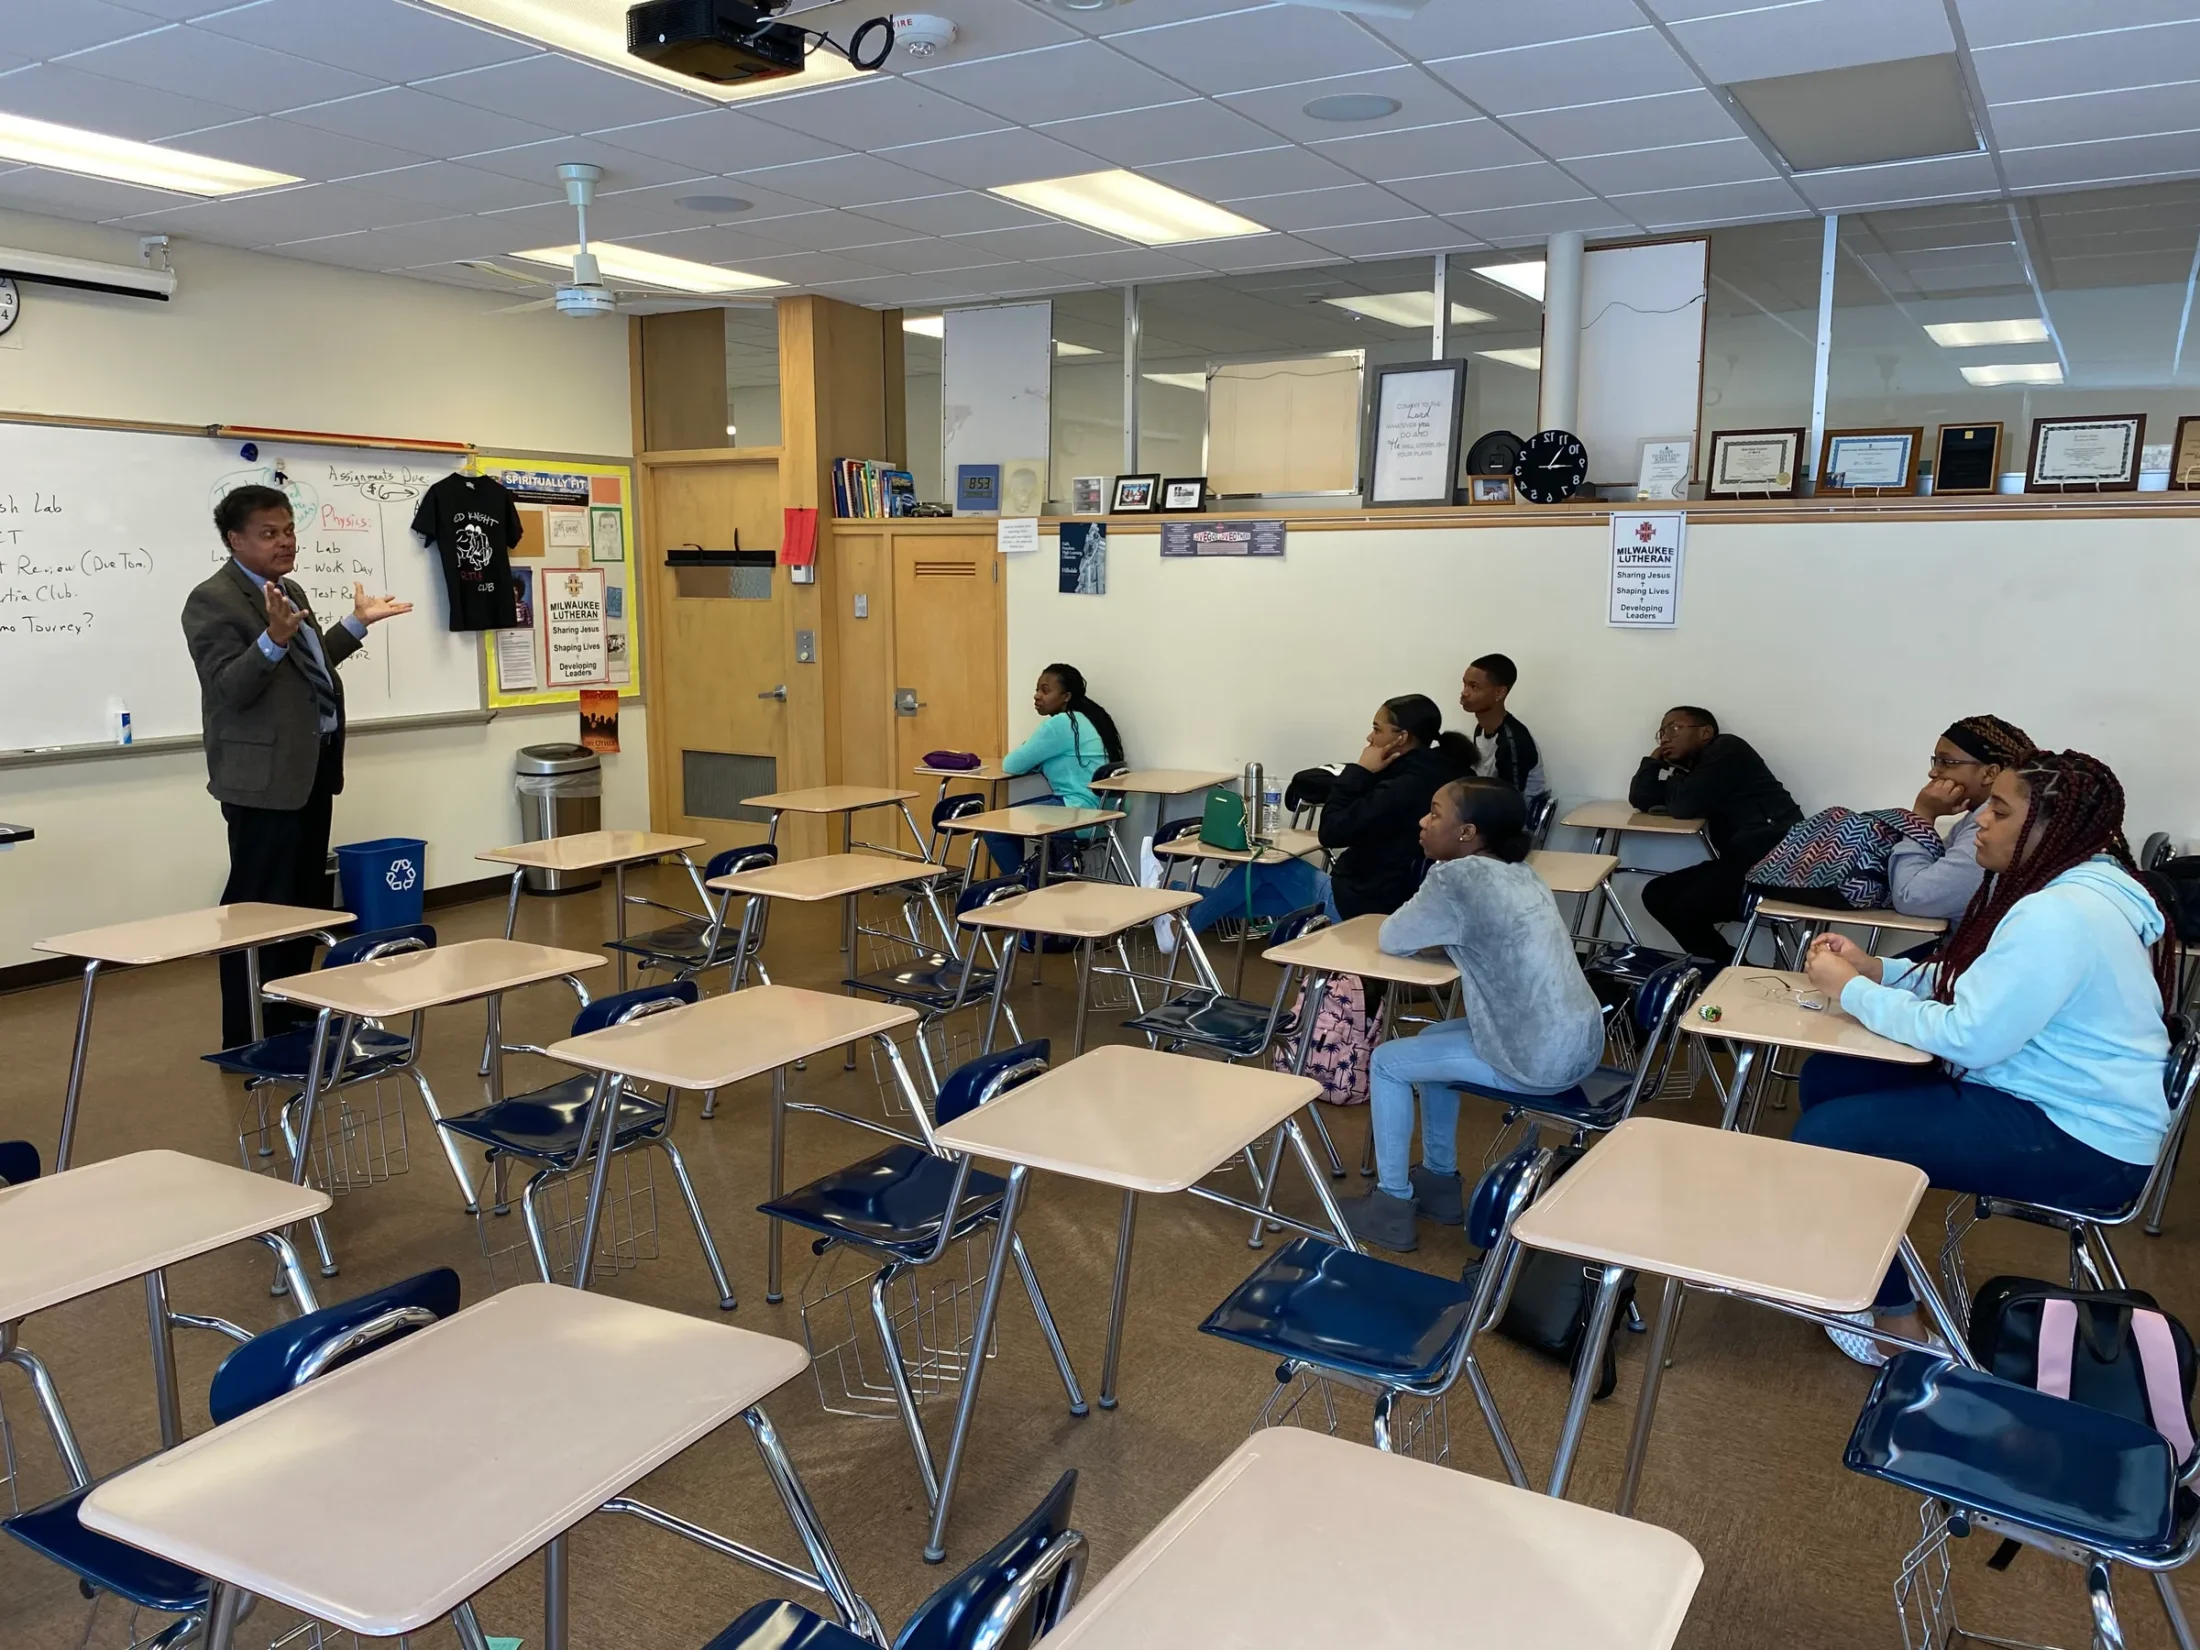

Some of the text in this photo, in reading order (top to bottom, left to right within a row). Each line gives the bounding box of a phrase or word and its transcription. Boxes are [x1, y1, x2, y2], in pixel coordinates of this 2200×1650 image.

[5, 293, 13, 305] 3
[1, 308, 9, 320] 4
[1407, 405, 1431, 419] Lord
[329, 465, 394, 487] Assignments
[505, 475, 586, 489] SPIRITUALLY FIT
[34, 493, 62, 513] Lab
[321, 503, 372, 529] Physics:
[316, 541, 341, 553] Lab
[1617, 546, 1675, 556] MILWAUKEE
[1619, 554, 1672, 563] LUTHERAN
[315, 559, 374, 576] Work Day
[1617, 571, 1646, 580] Sharing
[310, 587, 337, 600] Test
[1616, 587, 1647, 596] Shaping
[550, 600, 600, 611] MILWAUKEE
[1620, 604, 1663, 613] Developing
[553, 610, 598, 620] LUTHERAN
[552, 626, 579, 635] Sharing
[553, 642, 601, 653] Shaping Lives
[559, 661, 597, 671] Developing
[565, 669, 592, 678] Leaders
